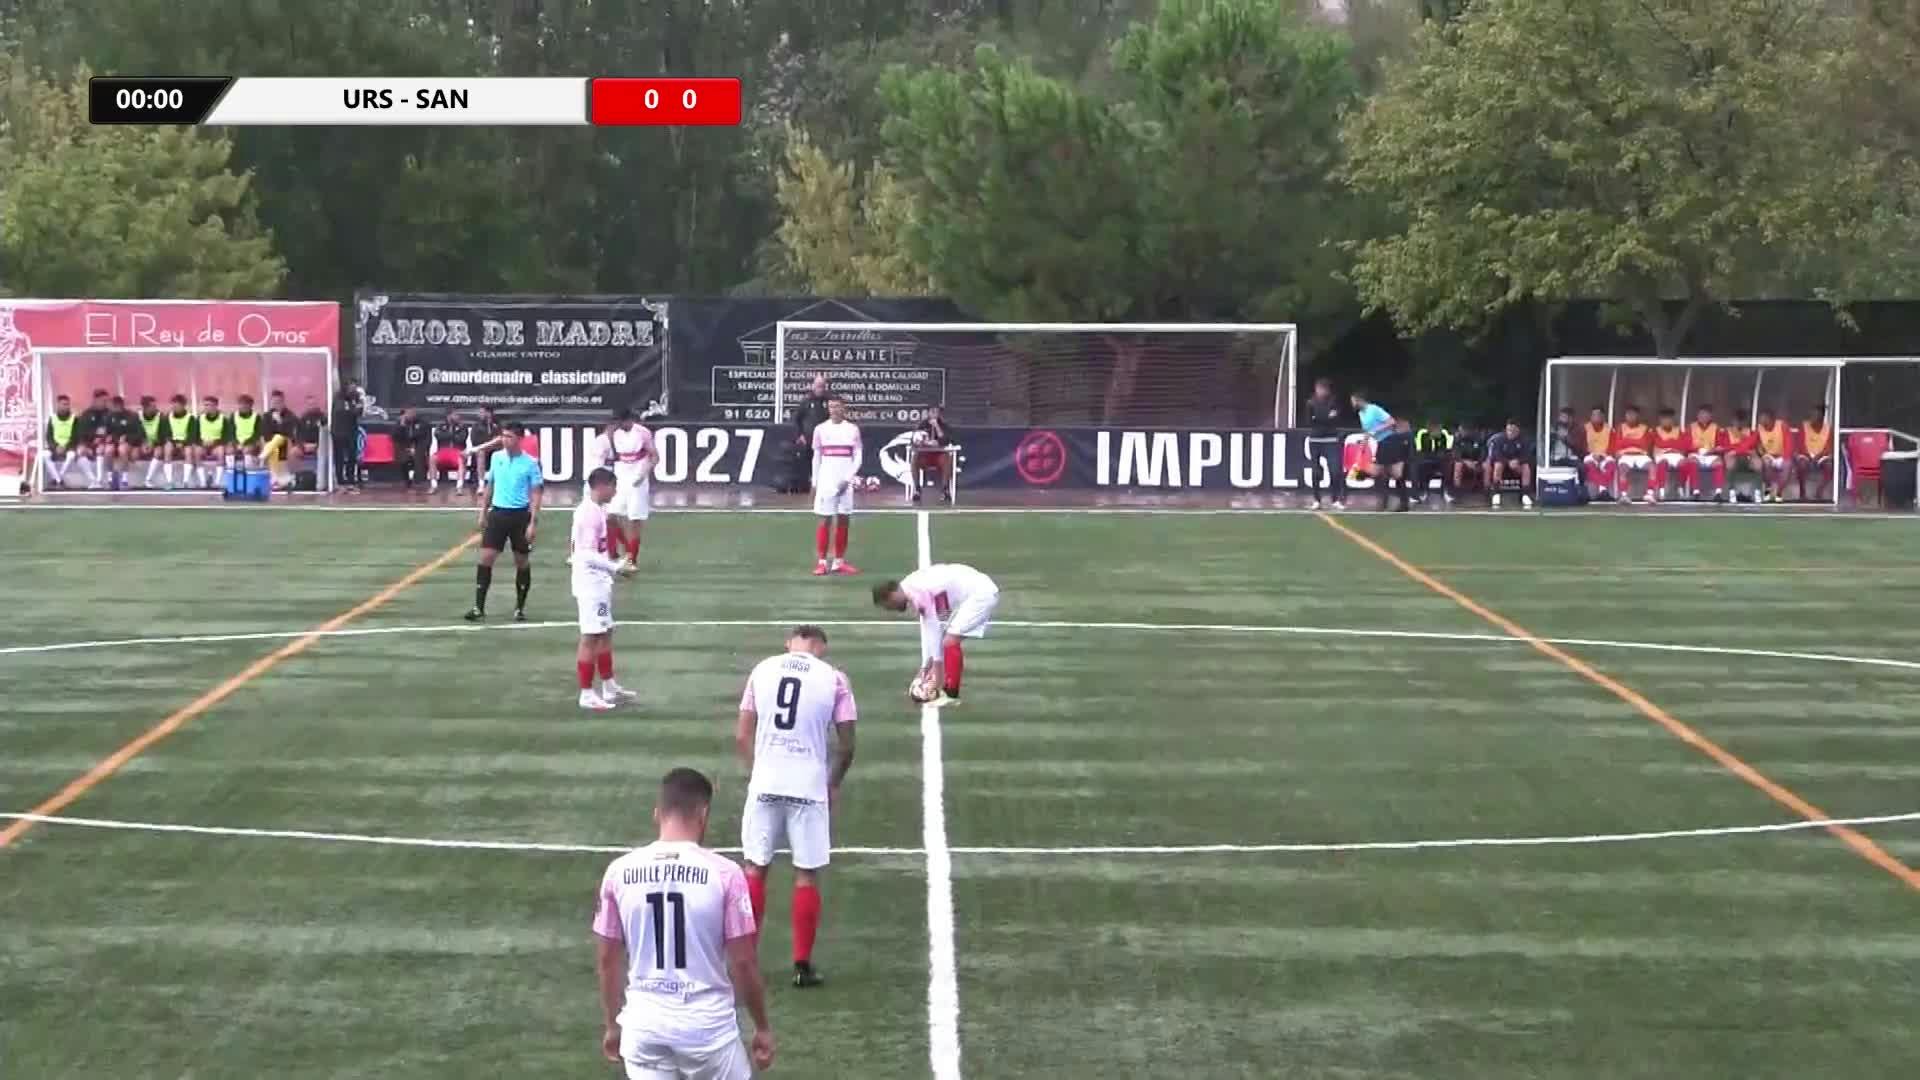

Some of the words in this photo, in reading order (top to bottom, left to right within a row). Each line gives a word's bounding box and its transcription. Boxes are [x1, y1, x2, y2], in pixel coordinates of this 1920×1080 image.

[84, 312, 117, 346] El
[130, 312, 185, 347] Rey
[196, 313, 225, 342] de
[237, 312, 310, 347] Oros
[371, 319, 472, 346] AMOR
[482, 319, 525, 346] DE
[535, 320, 654, 347] MADRE
[520, 351, 561, 359] TATTOO
[724, 409, 740, 420] 91
[745, 409, 771, 420] 620
[774, 676, 802, 731] 9
[623, 864, 660, 885] GUILLE
[663, 863, 709, 885] PERERO
[645, 891, 687, 970] 11
